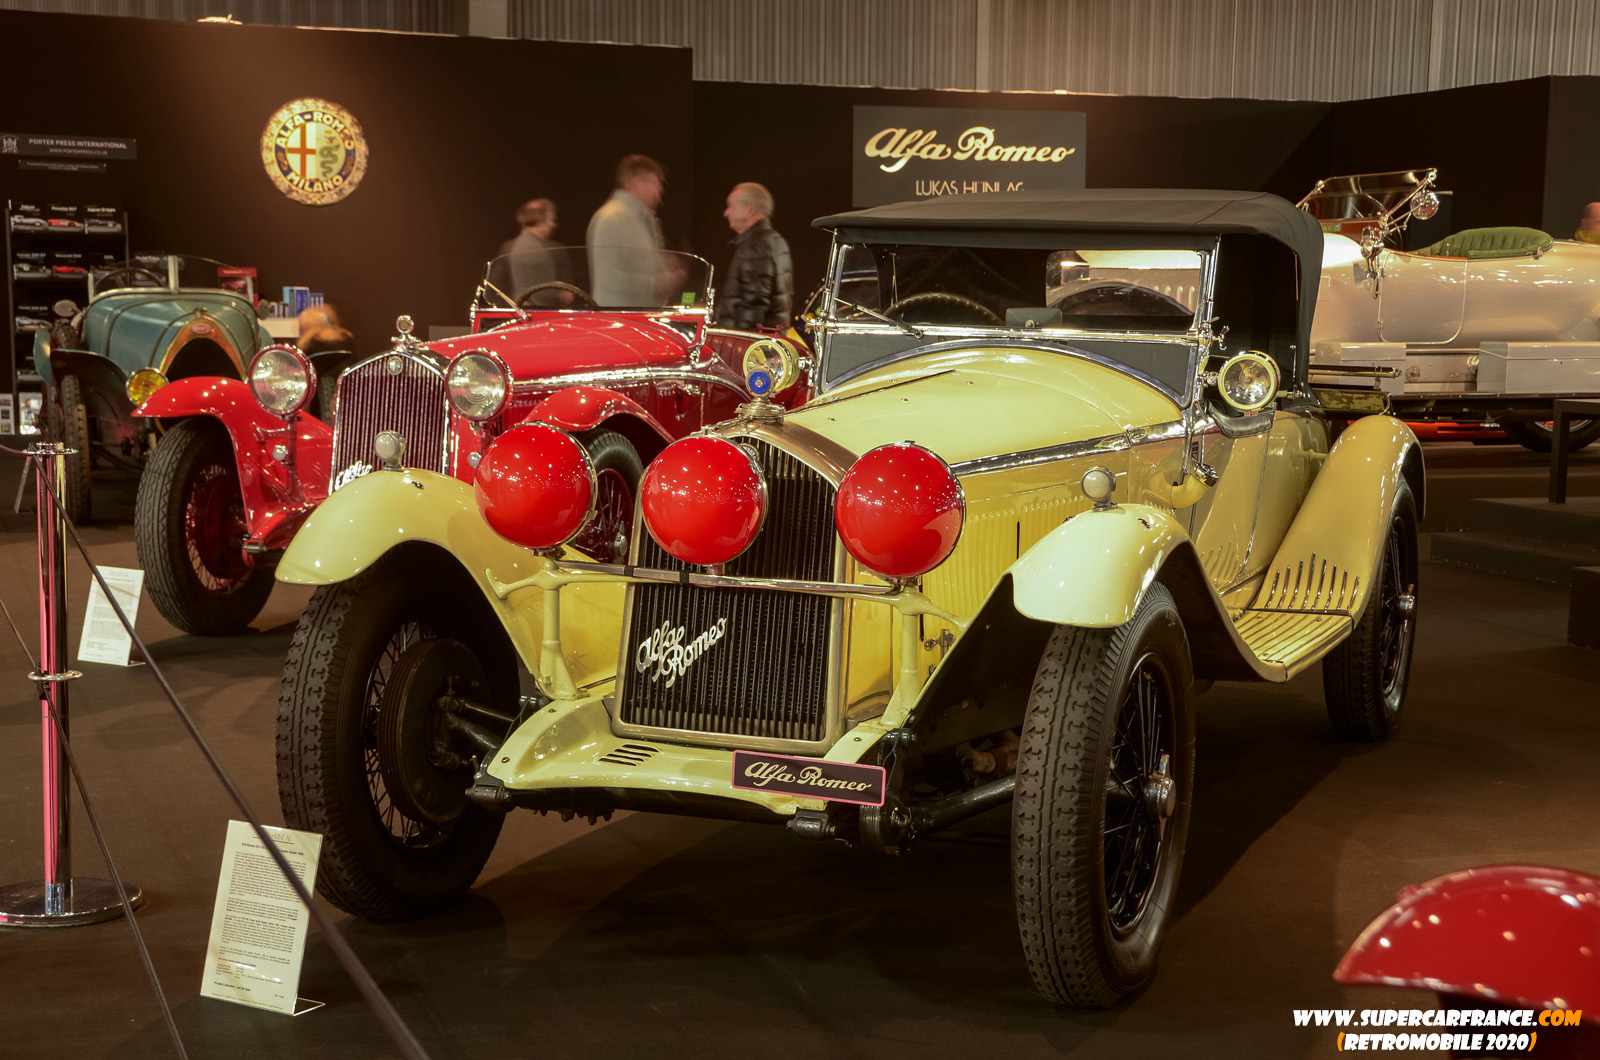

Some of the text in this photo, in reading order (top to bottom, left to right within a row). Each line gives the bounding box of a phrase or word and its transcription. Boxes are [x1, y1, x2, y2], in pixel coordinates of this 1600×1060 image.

[29, 138, 128, 150] PORTER PRESS INTERNATIONAL
[864, 126, 1076, 173] Alfa Romeo
[287, 172, 343, 192] MILANO
[915, 180, 959, 196] LUKAS
[636, 619, 685, 683] Alfa
[660, 617, 727, 689] Romeo
[744, 761, 872, 792] Alfa Romeo
